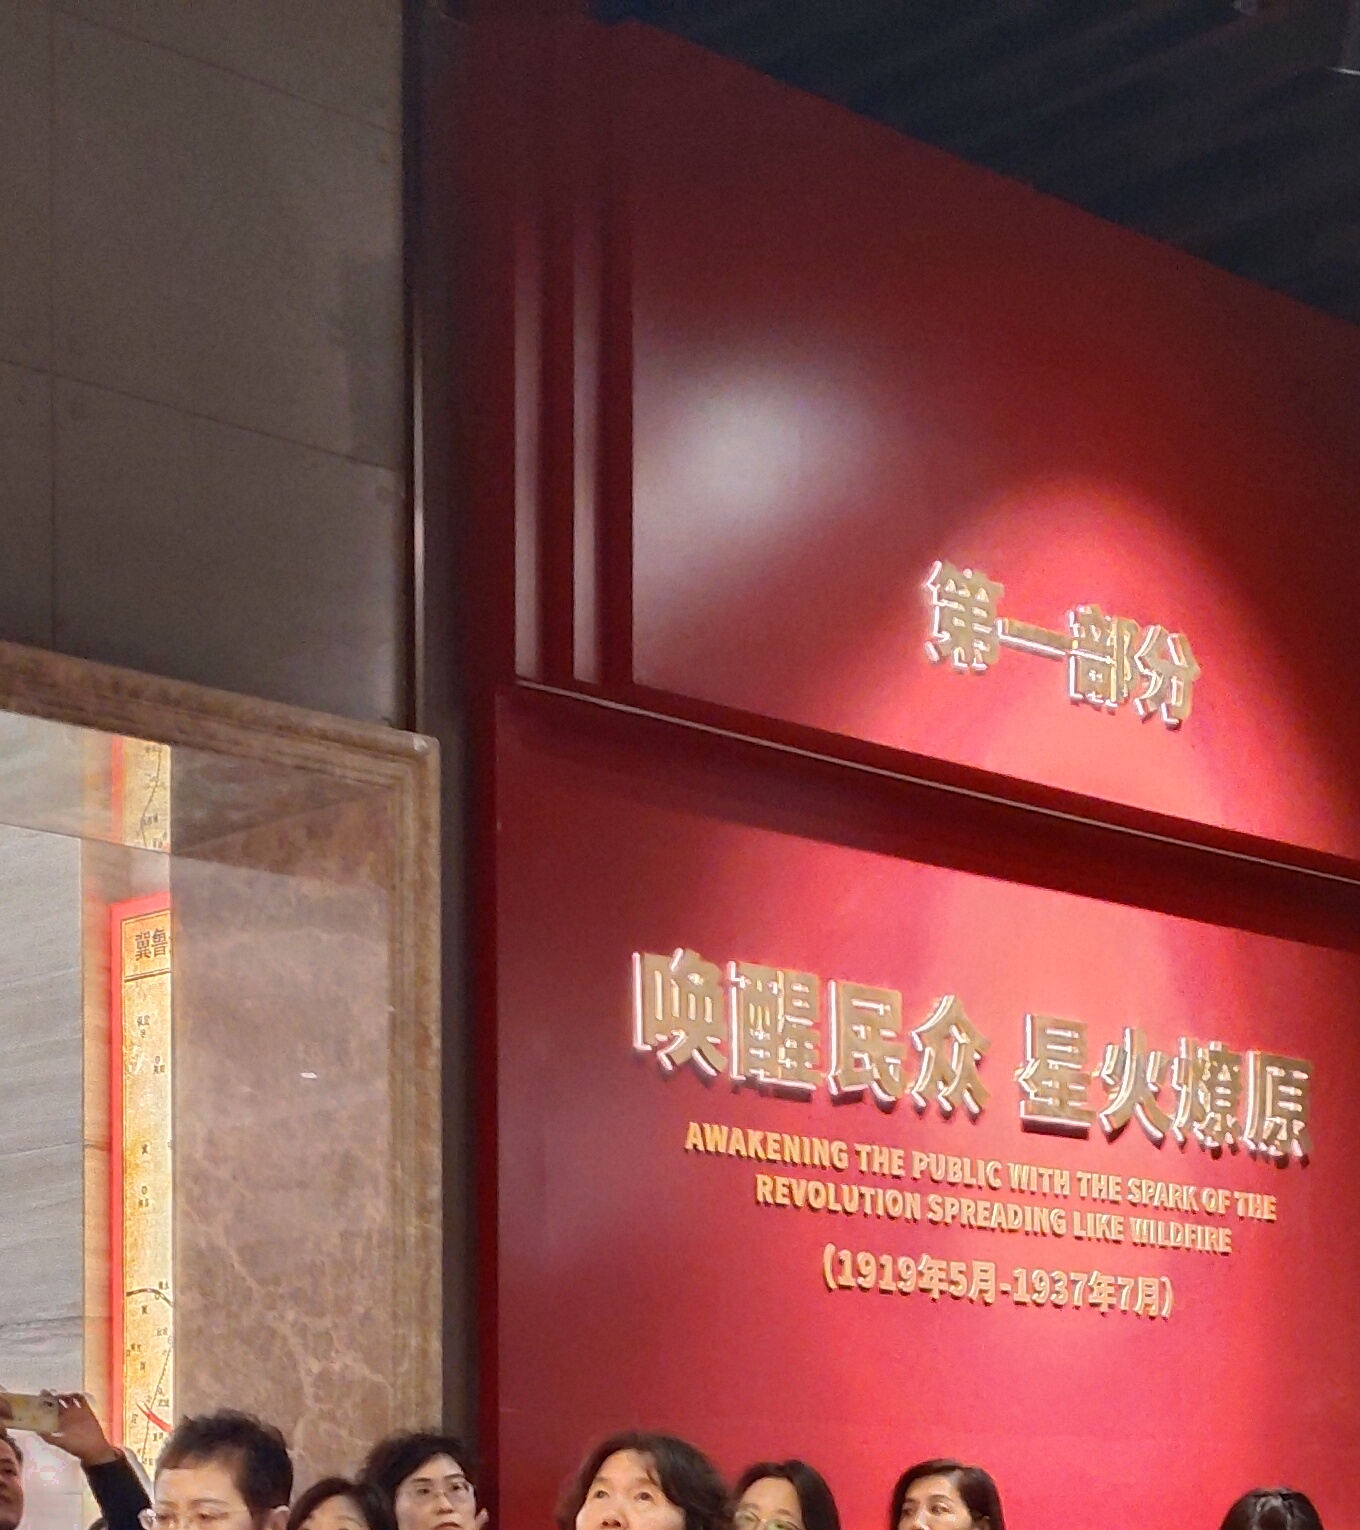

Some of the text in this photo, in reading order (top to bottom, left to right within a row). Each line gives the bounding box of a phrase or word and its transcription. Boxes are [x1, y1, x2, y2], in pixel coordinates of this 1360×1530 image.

[925, 559, 1201, 730] 第一部分
[135, 928, 172, 961] 冀鲁
[630, 948, 1314, 1168] 唤醒民众 星火燎原
[684, 1121, 1278, 1223] AWAKENING THE PUBLIC WITH THE SPARK OF THE
[755, 1173, 1233, 1256] REVOLUTION SPREADING LIKE WILDFIRE
